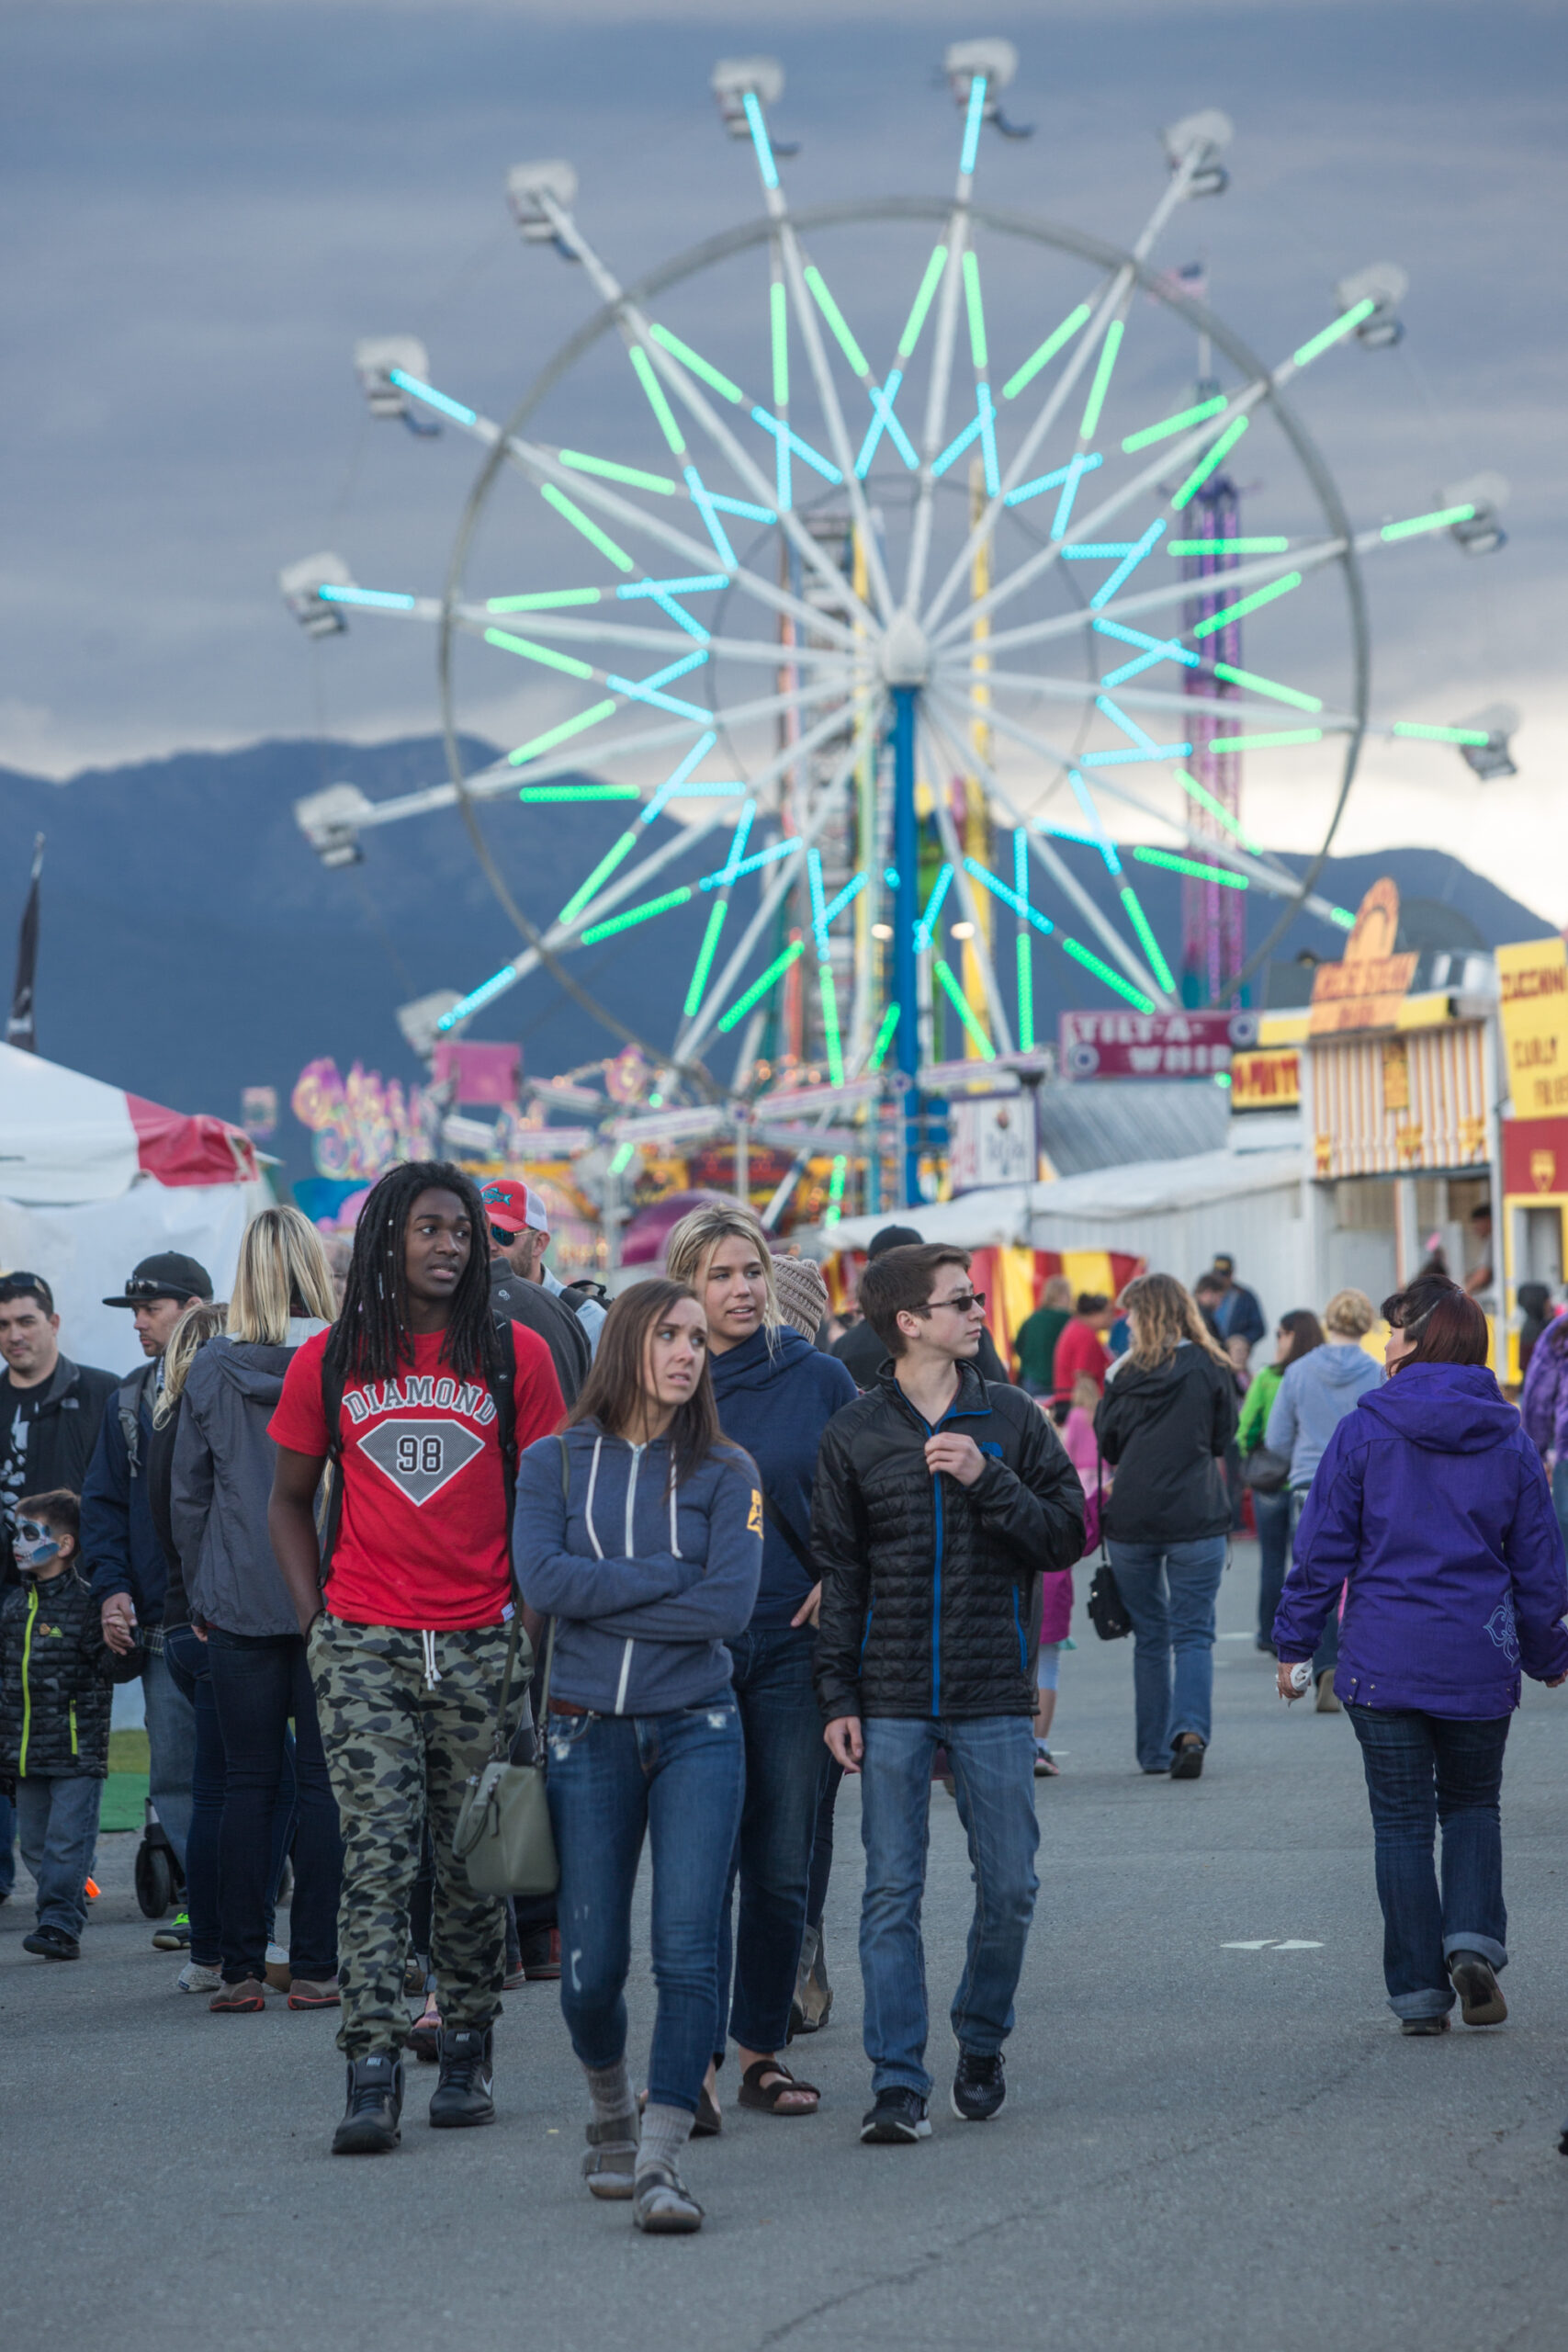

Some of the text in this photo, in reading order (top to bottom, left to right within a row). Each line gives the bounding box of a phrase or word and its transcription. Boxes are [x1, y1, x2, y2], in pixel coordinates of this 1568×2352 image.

[342, 1375, 497, 1425] DIAMOND
[397, 1435, 444, 1475] 98
[366, 2058, 382, 2066] NIKE
